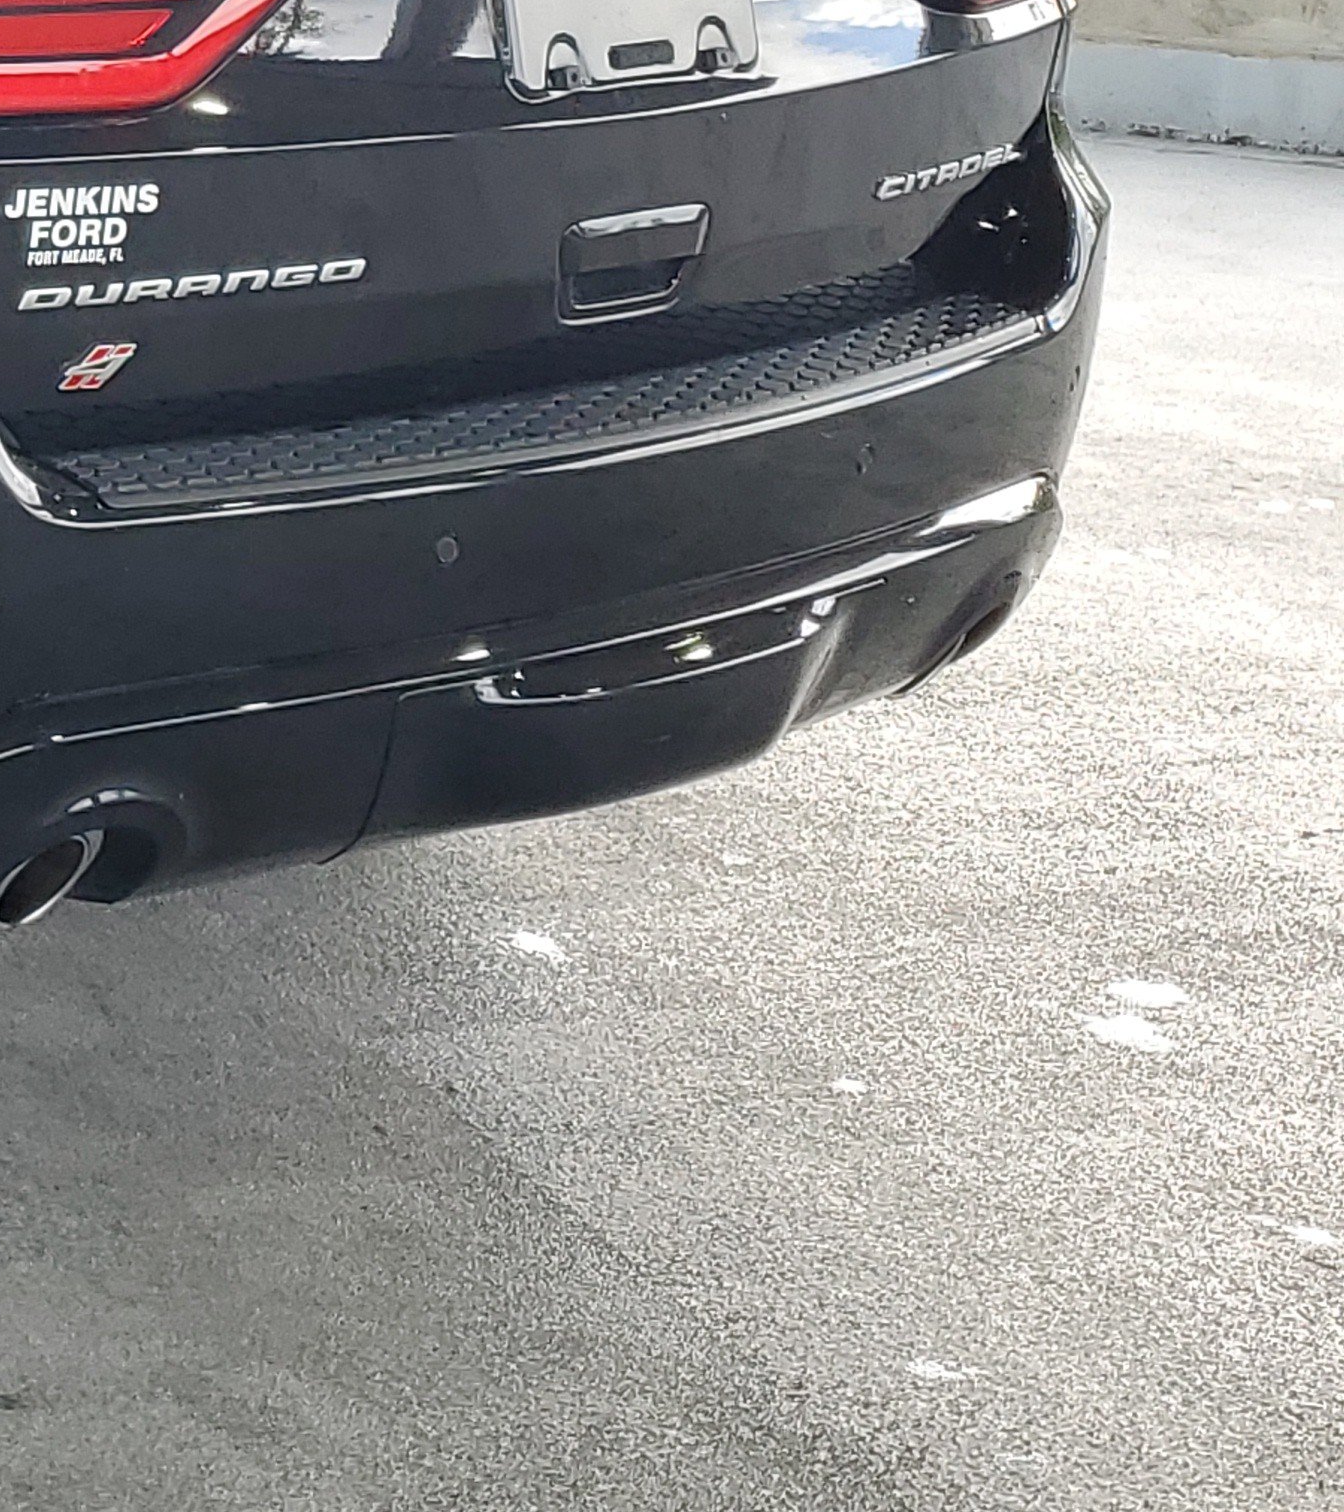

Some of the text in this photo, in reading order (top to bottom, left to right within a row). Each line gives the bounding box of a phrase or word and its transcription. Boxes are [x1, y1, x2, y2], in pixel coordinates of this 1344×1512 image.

[873, 142, 1023, 202] CITADEL
[3, 184, 161, 220] JENKINS
[28, 217, 128, 249] FORD
[27, 247, 124, 267] FORT MEADE, FL
[17, 258, 368, 311] DURANGO
